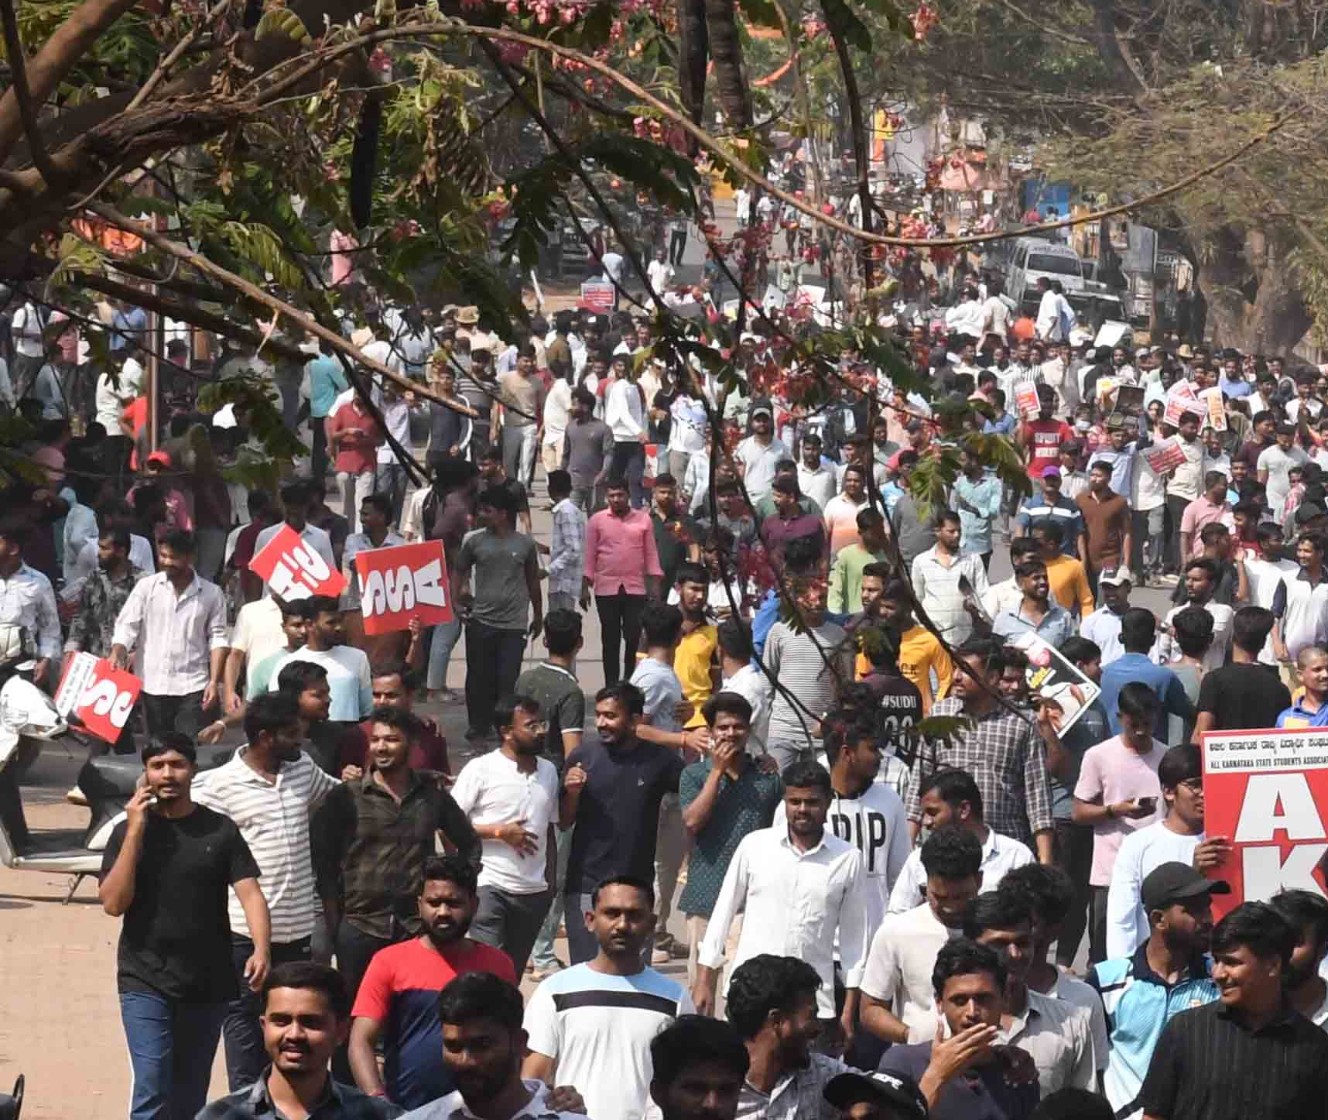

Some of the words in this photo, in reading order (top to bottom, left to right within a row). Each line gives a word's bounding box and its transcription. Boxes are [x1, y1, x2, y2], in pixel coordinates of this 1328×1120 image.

[1210, 761, 1221, 769] ALL
[1222, 759, 1255, 769] KARNATAKA
[1255, 758, 1273, 768] STATE
[1273, 757, 1302, 767] STUDENTS
